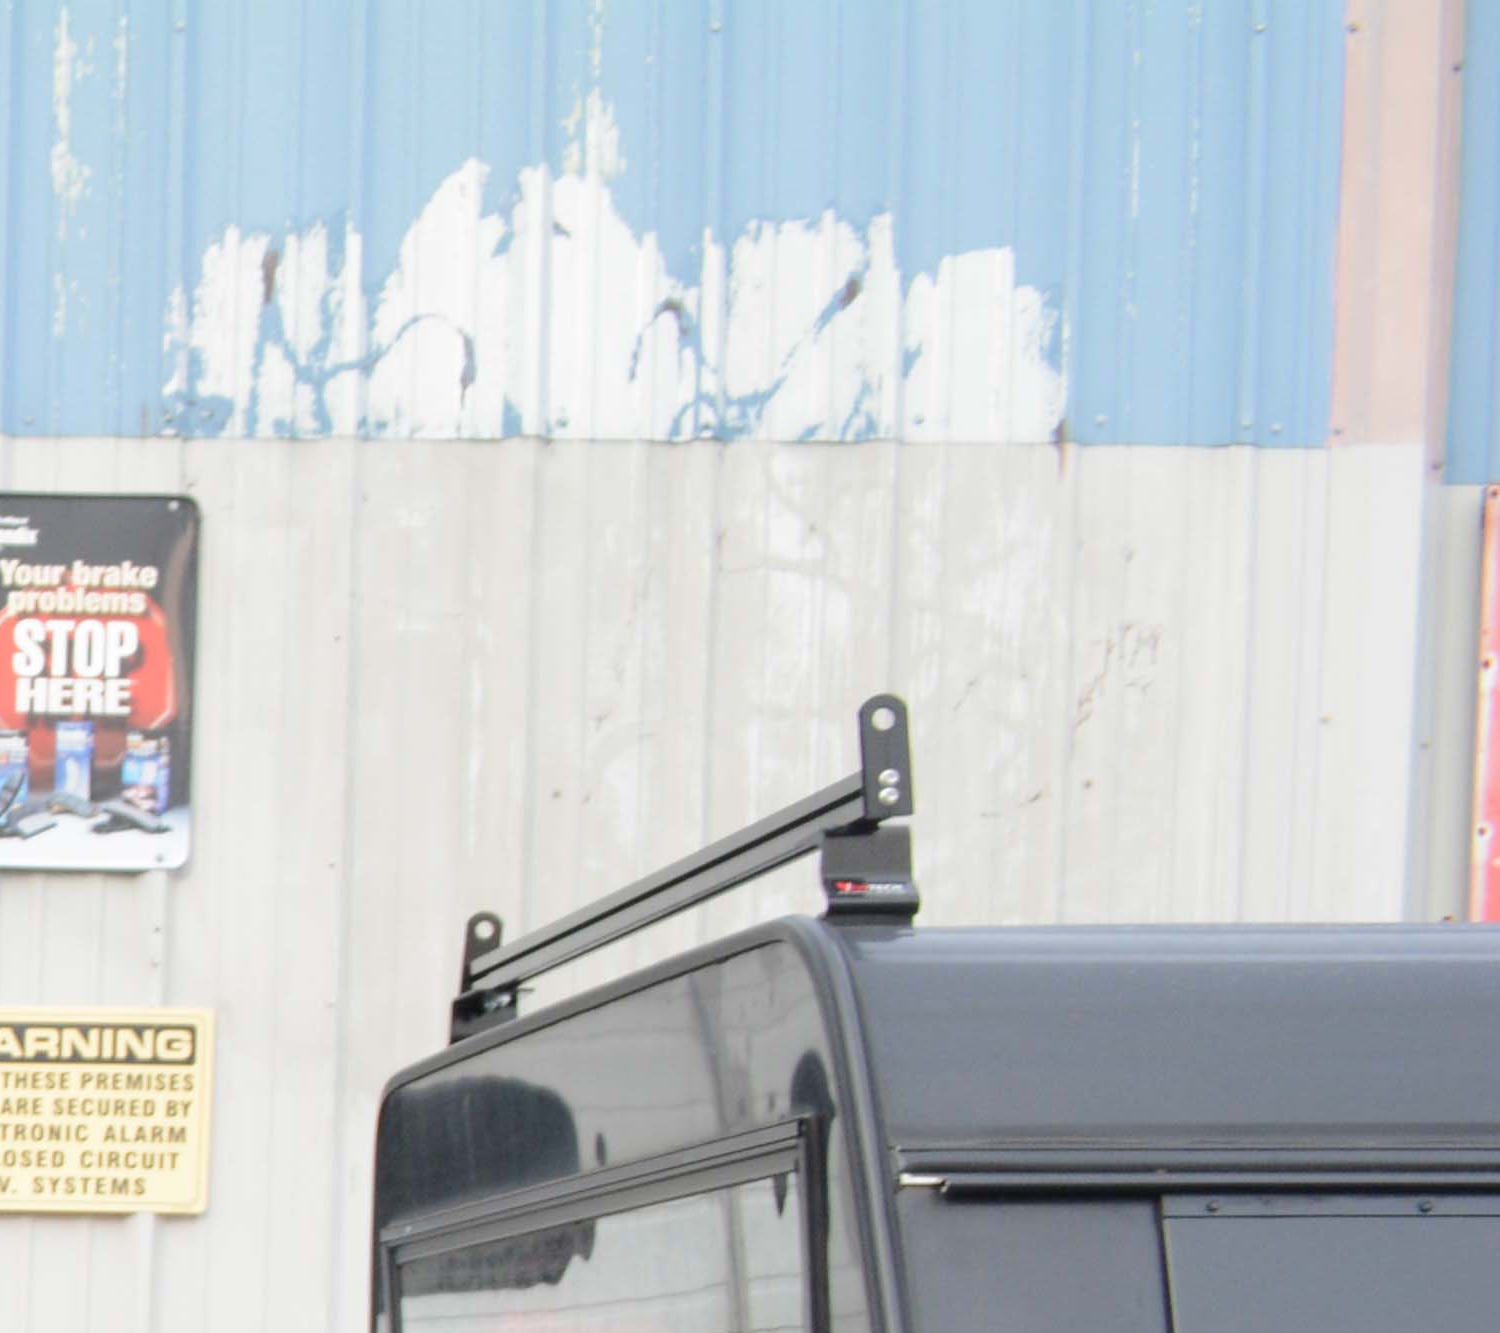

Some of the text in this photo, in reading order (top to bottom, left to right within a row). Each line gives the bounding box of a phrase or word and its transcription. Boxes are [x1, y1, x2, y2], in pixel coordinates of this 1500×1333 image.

[71, 559, 159, 589] brake
[7, 586, 148, 617] problems
[11, 618, 139, 678] STOP
[15, 678, 133, 716] HERE
[1, 1071, 195, 1092] THESE PREMISES
[0, 1098, 193, 1118] ARE SECURED BY
[102, 1124, 188, 1144] ALARM
[79, 1150, 181, 1170] CIRCUIT
[32, 1176, 147, 1196] SYSTEMS
